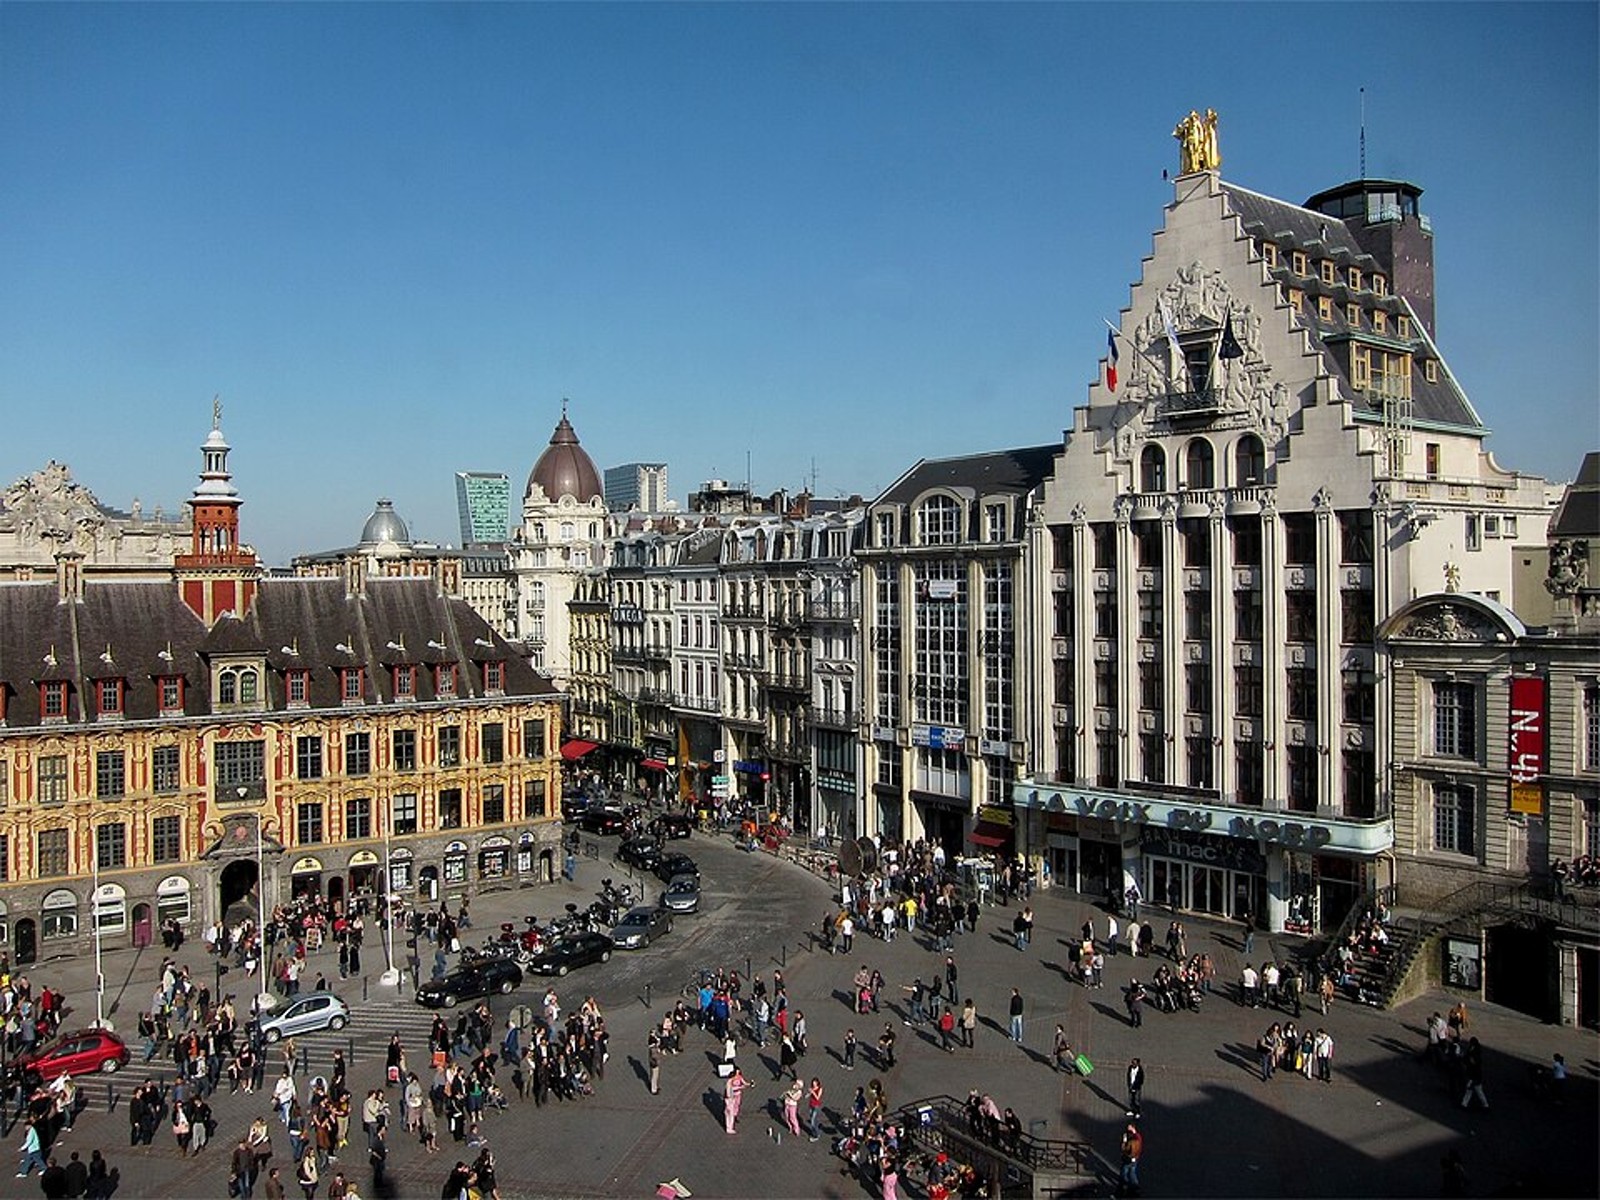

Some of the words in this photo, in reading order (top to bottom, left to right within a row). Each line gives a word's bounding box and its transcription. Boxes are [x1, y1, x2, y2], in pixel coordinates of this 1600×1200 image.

[1028, 790, 1067, 812] LA
[1075, 796, 1152, 824] VOIX
[1167, 808, 1212, 831] DU
[1228, 816, 1332, 847] NORD
